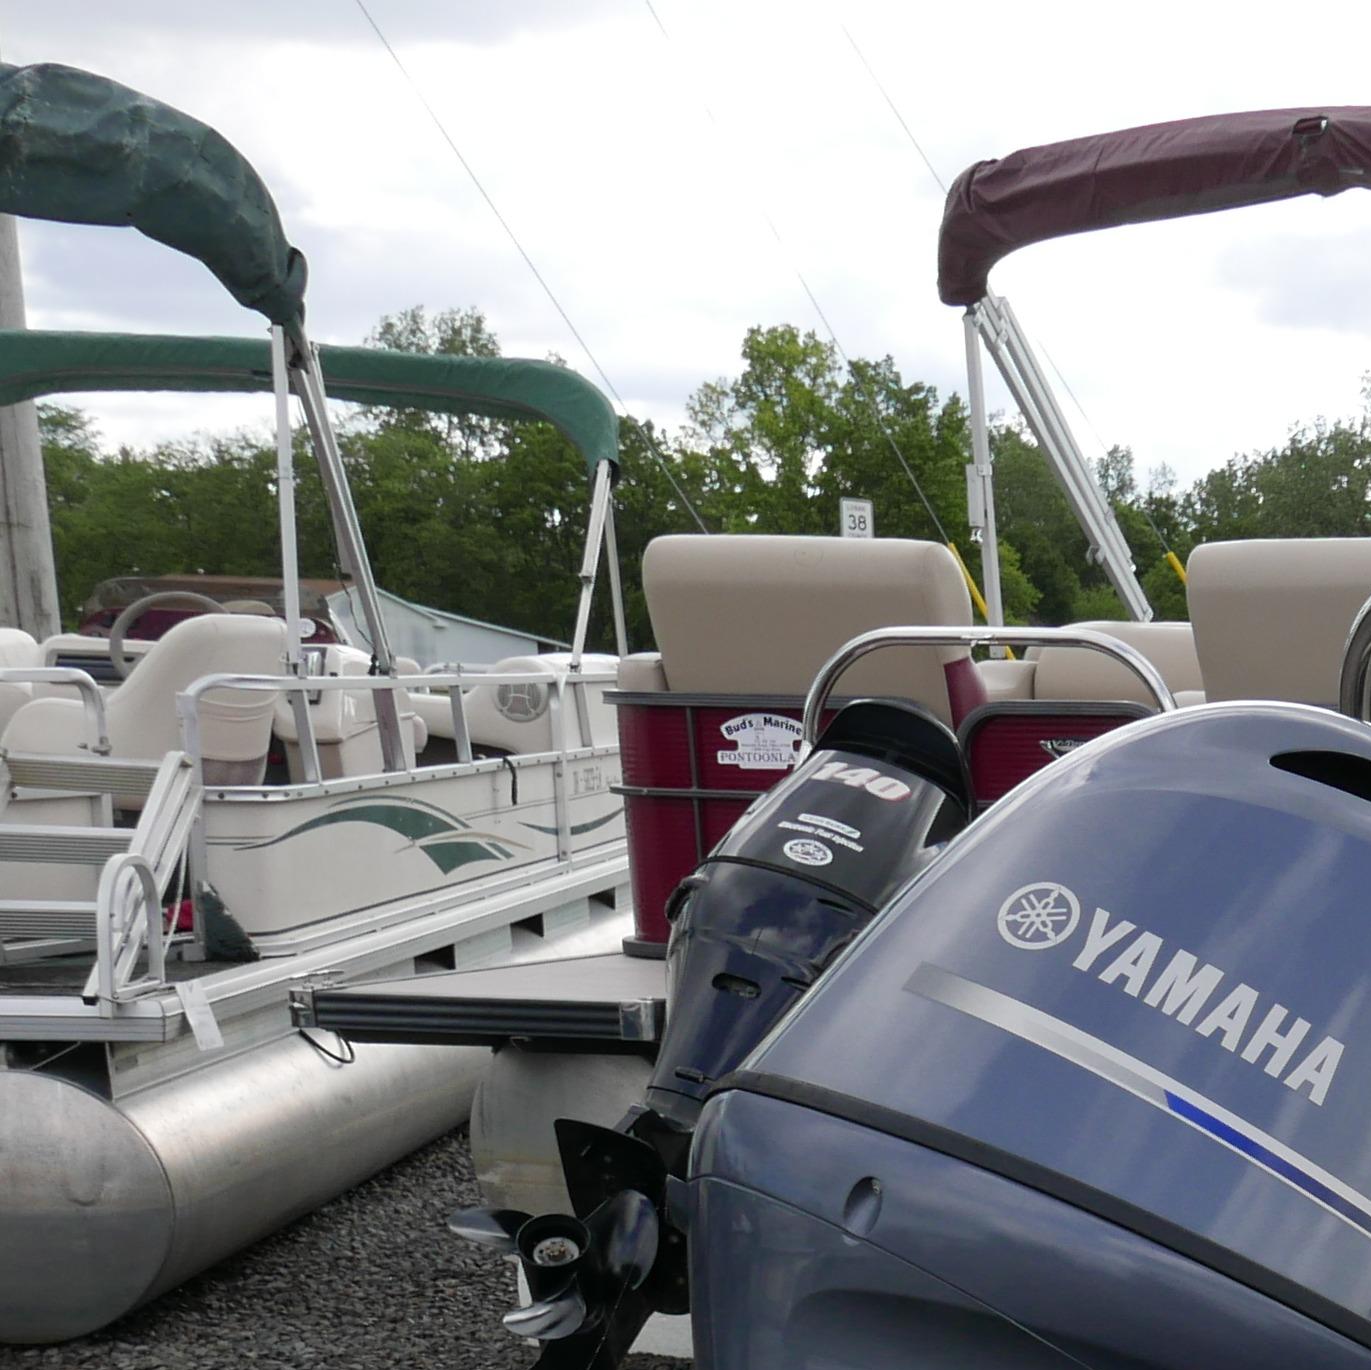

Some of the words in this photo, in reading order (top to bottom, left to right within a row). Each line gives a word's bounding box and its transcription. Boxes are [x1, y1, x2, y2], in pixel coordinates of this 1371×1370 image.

[848, 513, 867, 531] 38
[763, 716, 802, 735] Marine
[719, 752, 796, 762] PONTOONLA
[810, 761, 912, 804] 140
[1072, 907, 1345, 1107] YAMAHA
